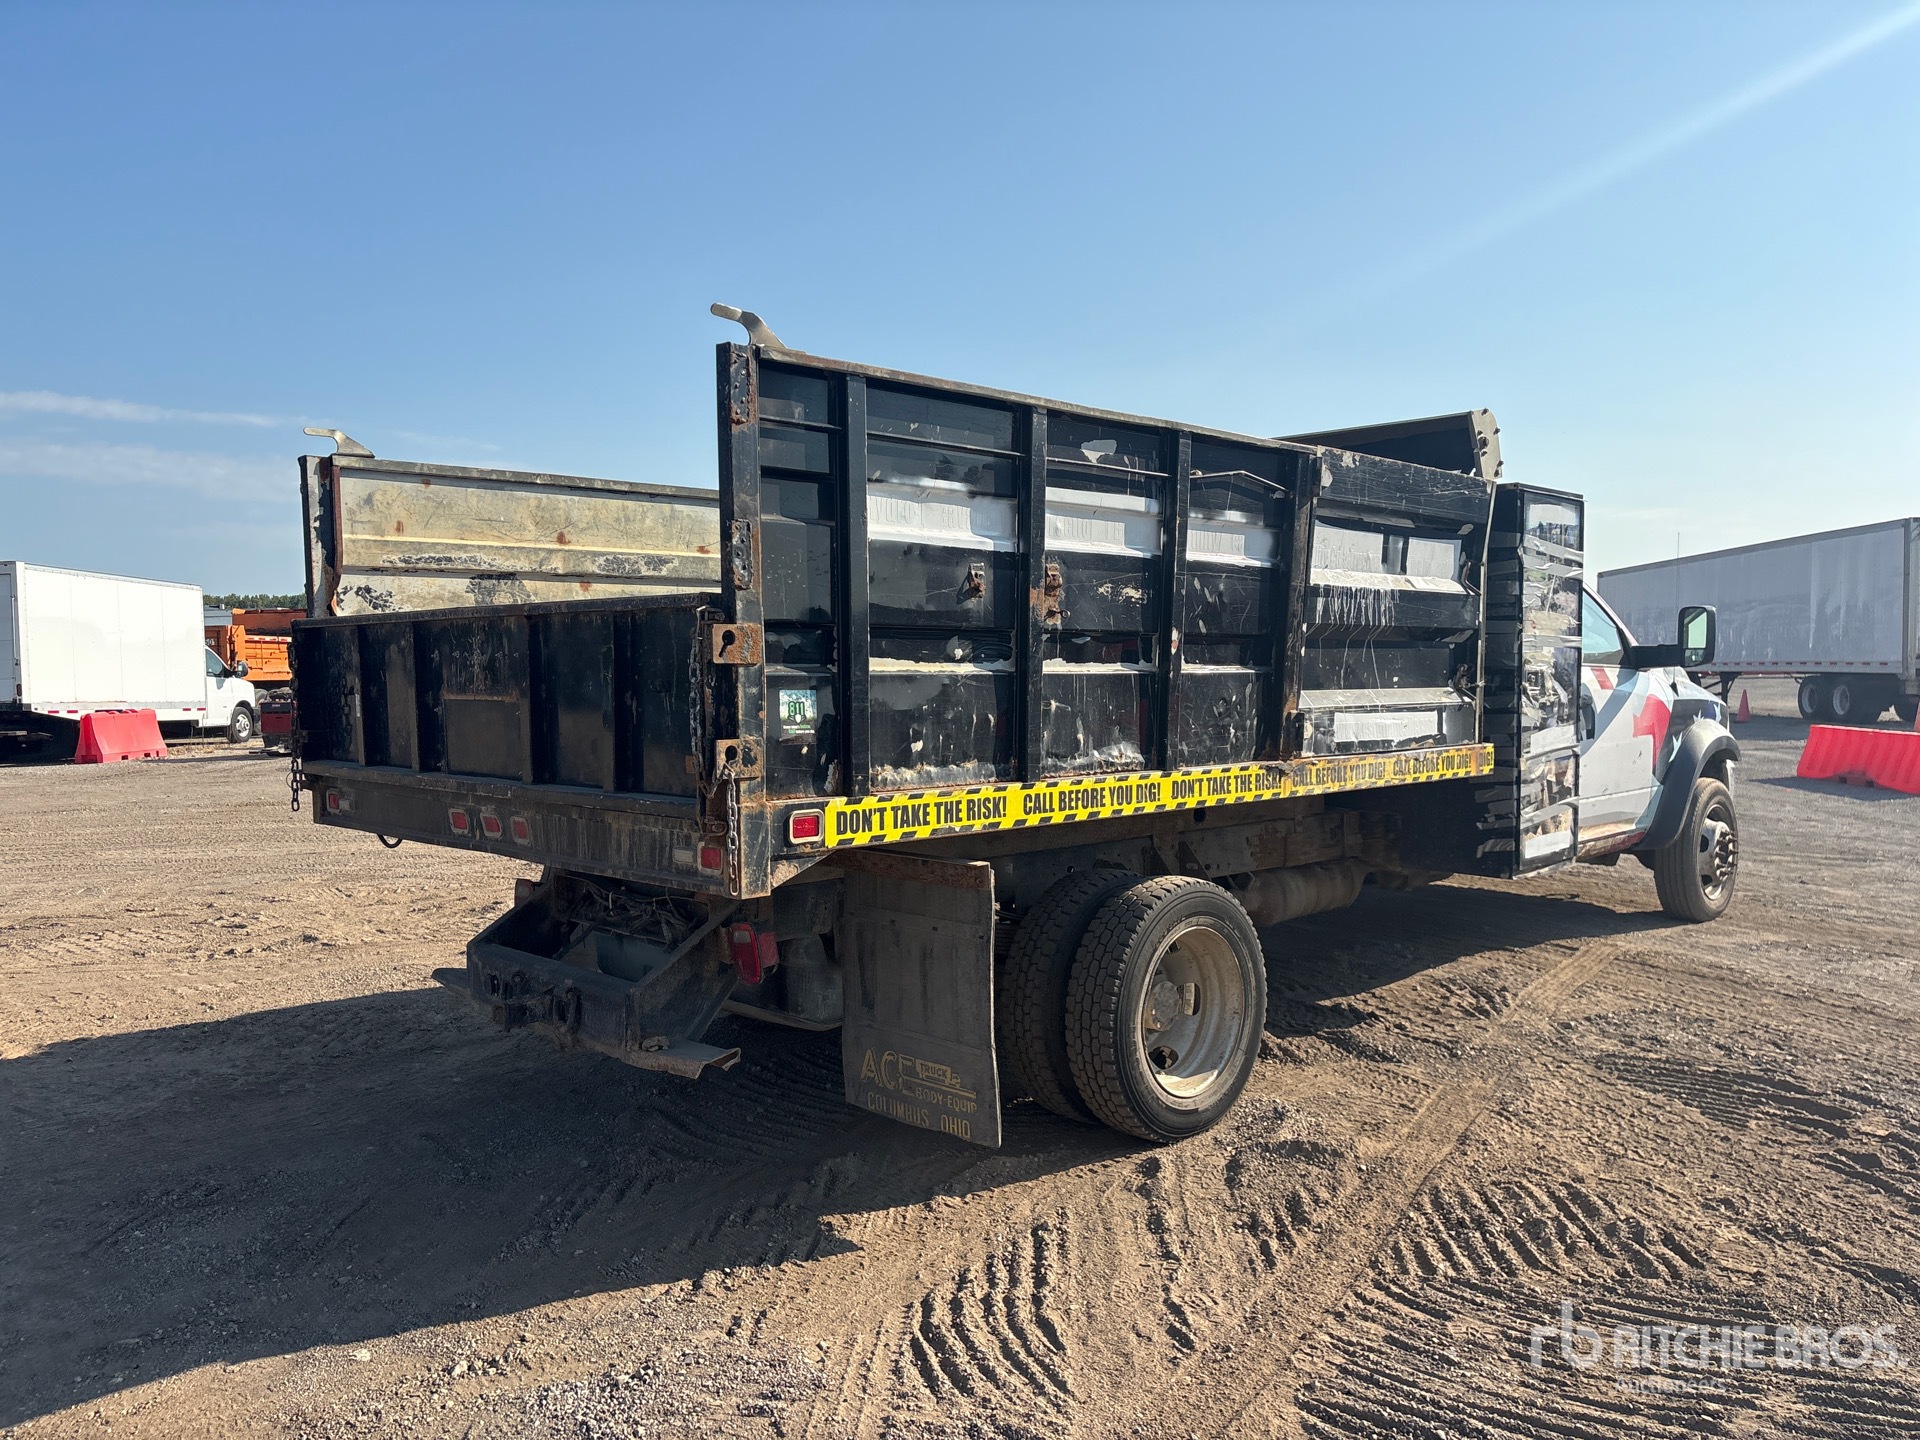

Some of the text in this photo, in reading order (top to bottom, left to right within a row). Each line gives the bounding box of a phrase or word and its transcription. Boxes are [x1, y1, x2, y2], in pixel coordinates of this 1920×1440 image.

[788, 701, 805, 717] 811
[836, 807, 887, 836] DON'T
[891, 804, 930, 829] TAKE
[934, 800, 962, 824] THE
[967, 796, 1007, 820] RISK!
[1023, 791, 1055, 815] CALL
[1058, 787, 1106, 812] BEFORE
[1109, 784, 1133, 806] YOU
[1136, 782, 1161, 803] DIG!
[1171, 778, 1204, 800] DON'T
[1206, 775, 1232, 796] TAKE
[1234, 774, 1253, 793] THE
[1255, 771, 1282, 791] RISK!
[1292, 768, 1313, 788] CALL
[1315, 765, 1348, 786] BEFORE
[1350, 763, 1367, 781] YOU
[1368, 761, 1386, 780] DIG!
[1393, 758, 1412, 777] CALL
[1413, 755, 1440, 775] BEFORE
[1441, 754, 1456, 771] YOU
[1457, 753, 1472, 769] DIG!
[861, 1048, 915, 1097] ACE
[919, 1062, 948, 1079] TRUCK
[867, 1092, 971, 1139] COLUMBUS OHIO
[915, 1087, 978, 1114] BODY-EQUIP
